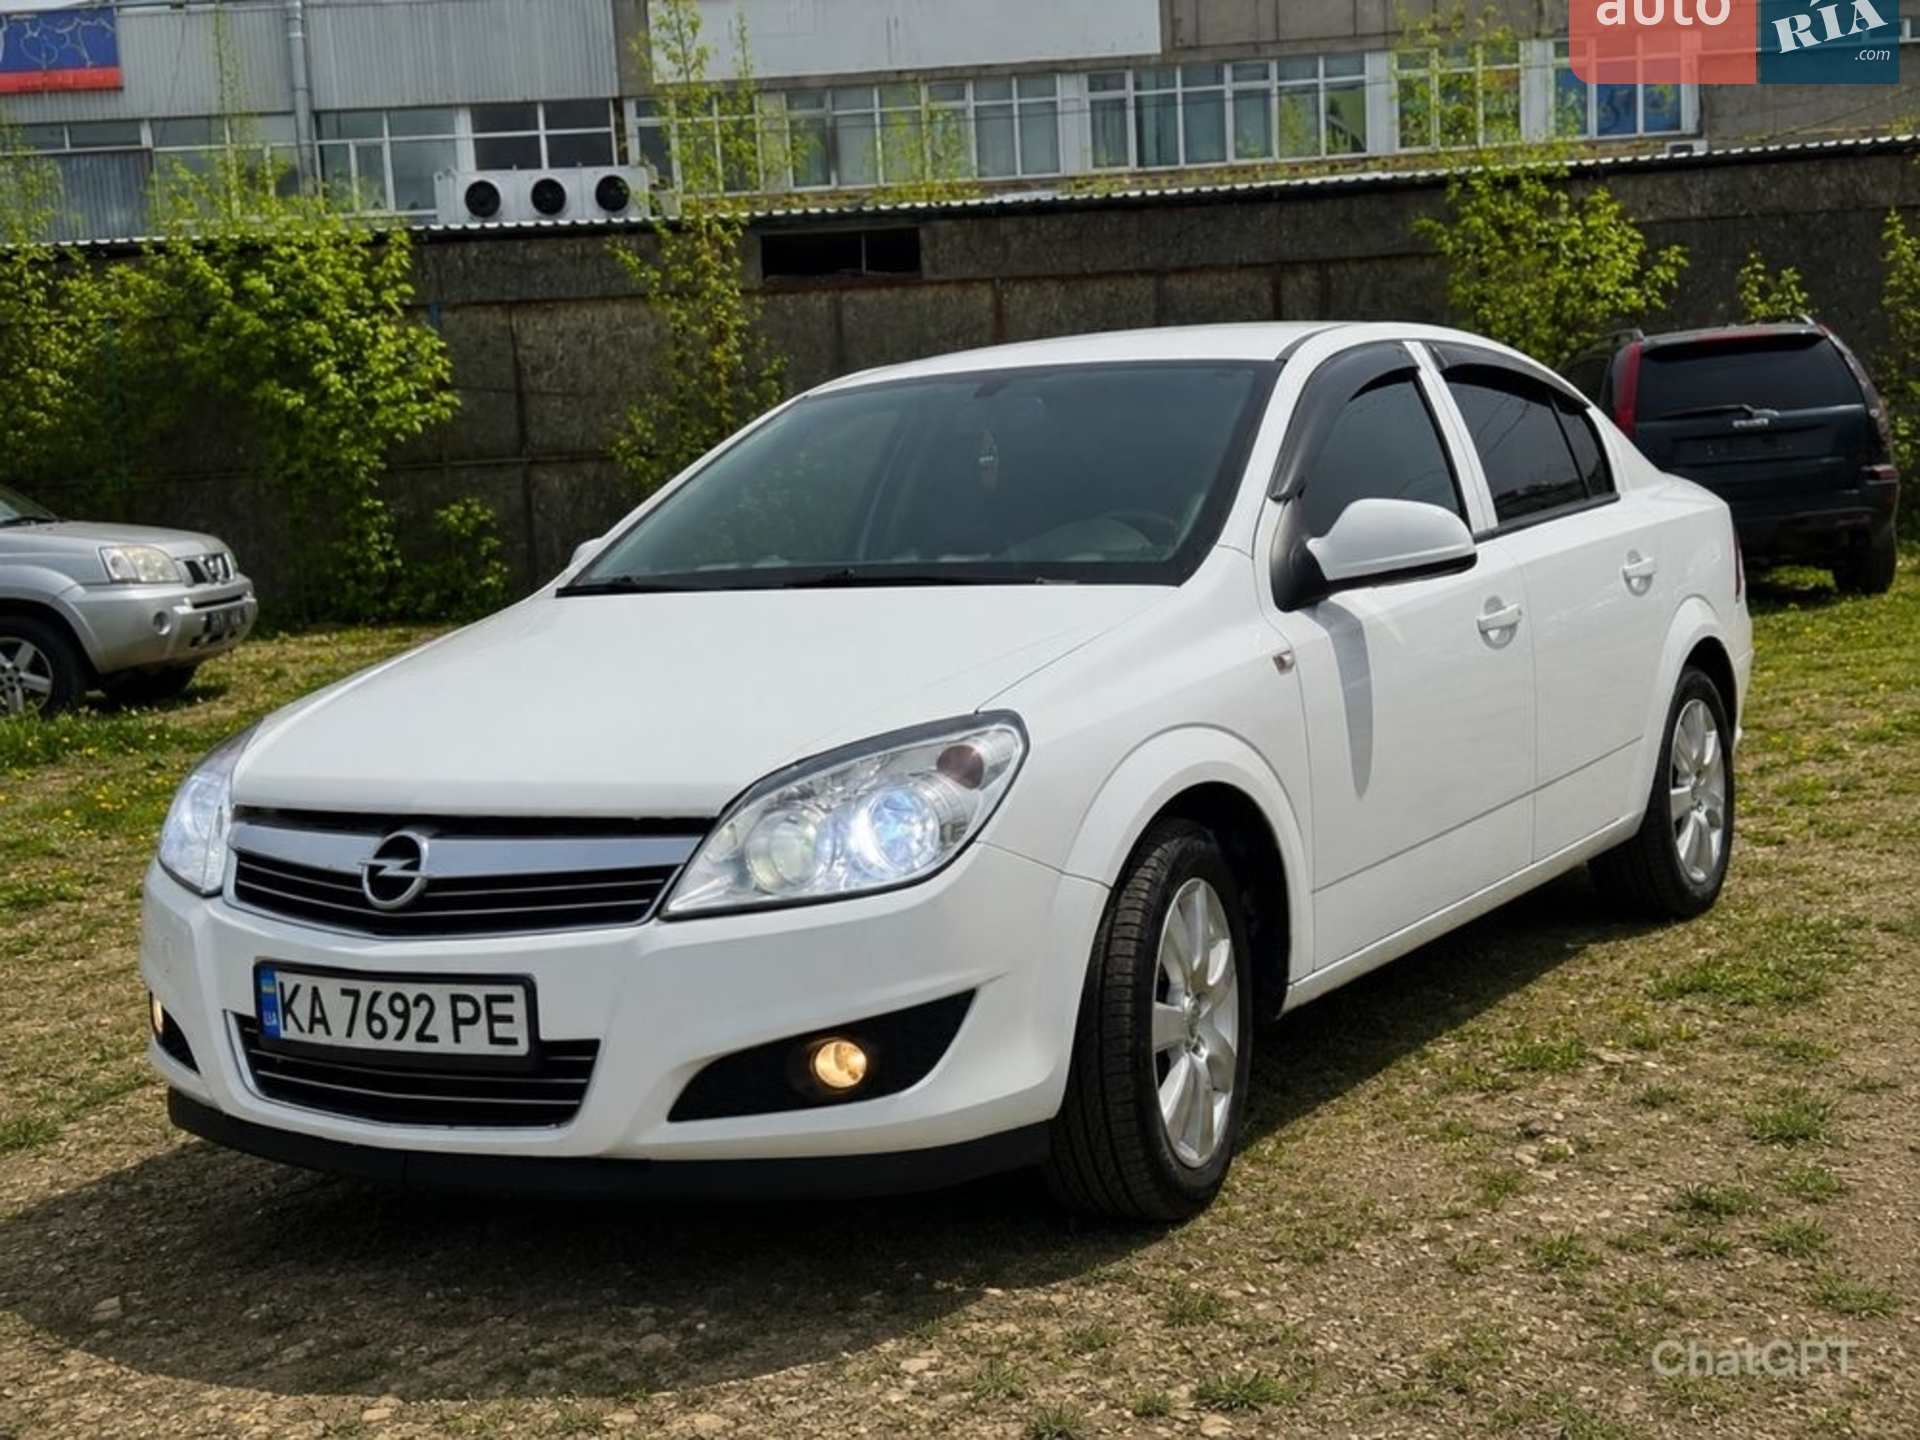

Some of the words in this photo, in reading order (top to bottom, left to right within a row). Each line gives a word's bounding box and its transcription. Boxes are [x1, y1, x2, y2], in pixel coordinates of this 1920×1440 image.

[279, 981, 332, 1036] KA
[340, 988, 439, 1043] 7692
[450, 993, 519, 1046] PE
